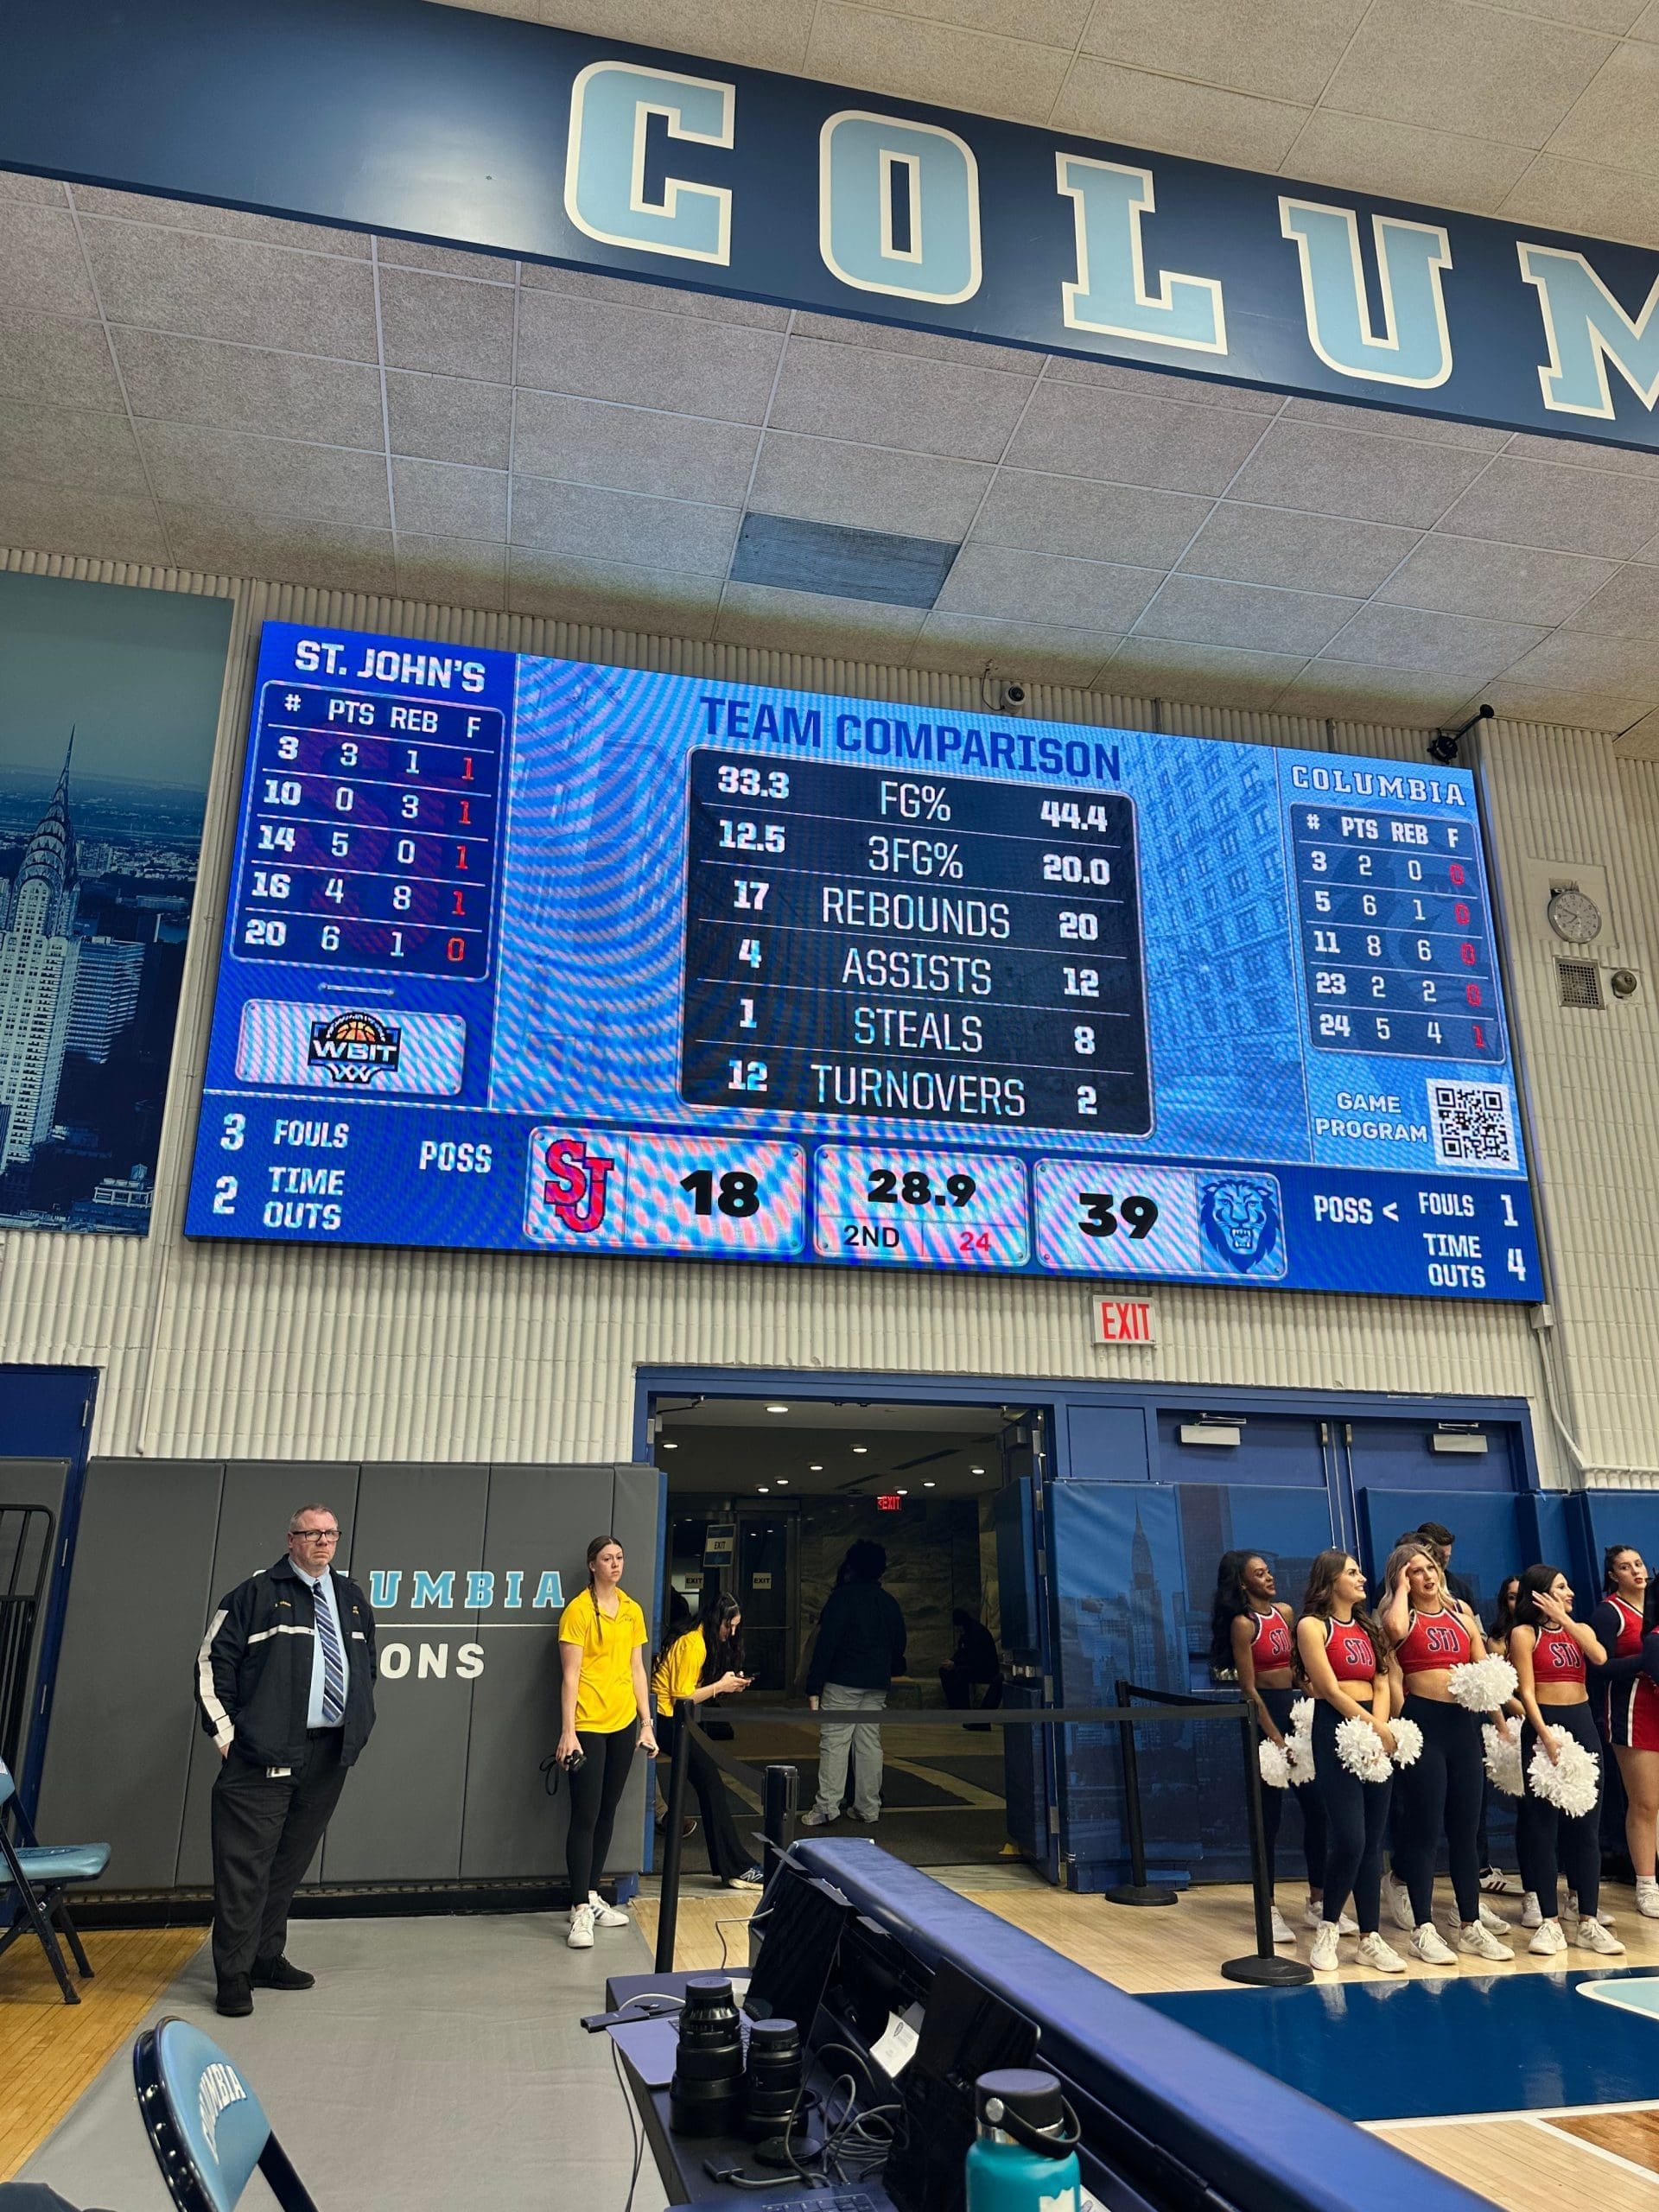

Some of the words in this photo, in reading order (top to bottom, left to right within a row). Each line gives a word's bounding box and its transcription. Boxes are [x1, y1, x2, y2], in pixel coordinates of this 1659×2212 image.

[295, 640, 346, 677] ST.
[357, 648, 486, 693] JOHN'S
[328, 699, 374, 726] PTS
[390, 706, 438, 734] REB
[467, 716, 480, 738] F
[700, 696, 821, 747] TEAM
[836, 714, 1121, 780] COMPARISON
[277, 735, 299, 760] 3
[340, 742, 359, 767] 3
[406, 749, 419, 774] 1
[461, 756, 474, 781] 1
[263, 779, 302, 806] 10
[336, 786, 353, 811] 0
[401, 794, 419, 820] 3
[459, 800, 472, 825] 1
[717, 766, 790, 799] 33.3
[880, 779, 951, 822] FG%
[1040, 799, 1108, 832] 44.4
[1291, 765, 1466, 807] COLUMBIA
[257, 824, 296, 852] 14
[331, 832, 349, 857] 5
[397, 839, 416, 864] 0
[455, 845, 468, 870] 1
[1341, 816, 1379, 840] PTS
[1391, 821, 1428, 845] REB
[1447, 829, 1459, 849] F
[718, 820, 786, 853] 12.5
[868, 836, 963, 880] 3FG%
[1043, 854, 1110, 886] 20.0
[1311, 850, 1327, 872] 3
[1358, 855, 1372, 876] 2
[1408, 860, 1422, 881] 0
[1449, 863, 1465, 885] 0
[251, 872, 290, 899] 16
[325, 878, 344, 905] 4
[393, 885, 411, 911] 8
[451, 891, 466, 916] 1
[734, 880, 769, 911] 17
[823, 887, 1010, 939] REBOUNDS
[1059, 912, 1098, 942] 20
[1314, 891, 1331, 912] 5
[1363, 894, 1377, 916] 6
[1413, 899, 1426, 920] 1
[1454, 903, 1470, 925] 0
[245, 919, 286, 948] 20
[321, 925, 340, 951] 6
[390, 932, 404, 957] 1
[447, 938, 465, 962] 0
[1313, 931, 1340, 954] 11
[1367, 935, 1382, 957] 8
[1417, 939, 1432, 961] 6
[738, 938, 761, 969] 4
[842, 947, 992, 995] ASSISTS
[1063, 967, 1099, 997] 12
[1316, 971, 1346, 995] 23
[1371, 976, 1386, 998] 2
[1422, 980, 1436, 1002] 2
[1466, 983, 1481, 1006] 0
[739, 998, 757, 1029] 1
[854, 1007, 982, 1053] STEALS
[1074, 1026, 1096, 1055] 8
[1319, 1014, 1351, 1037] 24
[1376, 1018, 1390, 1039] 5
[1427, 1021, 1441, 1044] 4
[1472, 1026, 1485, 1048] 1
[313, 1039, 397, 1062] WBIT
[728, 1059, 767, 1091] 12
[810, 1064, 1025, 1116] TURNOVERS
[1077, 1085, 1097, 1115] 2
[1336, 1091, 1402, 1114] GAME
[219, 1113, 247, 1151] 3
[273, 1119, 349, 1149] FOULS
[1314, 1117, 1428, 1143] PROGRAM
[419, 1141, 493, 1174] POSS
[213, 1175, 238, 1215] 2
[268, 1166, 346, 1196] TIME
[680, 1169, 760, 1217] 18
[868, 1169, 976, 1207] 28.9
[263, 1200, 342, 1230] OUTS
[1077, 1192, 1159, 1240] 39
[1313, 1194, 1373, 1224] POSS
[1418, 1192, 1474, 1217] FOULS
[1501, 1194, 1519, 1227] 1
[843, 1224, 899, 1249] 2ND
[959, 1232, 992, 1252] 24
[1423, 1232, 1482, 1259] TIME
[1428, 1263, 1486, 1289] OUTS
[1507, 1248, 1526, 1282] 4
[1102, 1301, 1150, 1341] EXIT
[882, 1496, 900, 1510] EXIT
[714, 1541, 726, 1549] EXIT
[369, 1570, 565, 1609] UMBIA
[685, 1576, 703, 1585] EXIT
[753, 1576, 771, 1585] EXIT
[1344, 1637, 1374, 1667] STJ
[1427, 1626, 1460, 1652] STJ
[1549, 1643, 1581, 1669] STJ
[379, 1643, 486, 1680] ONS
